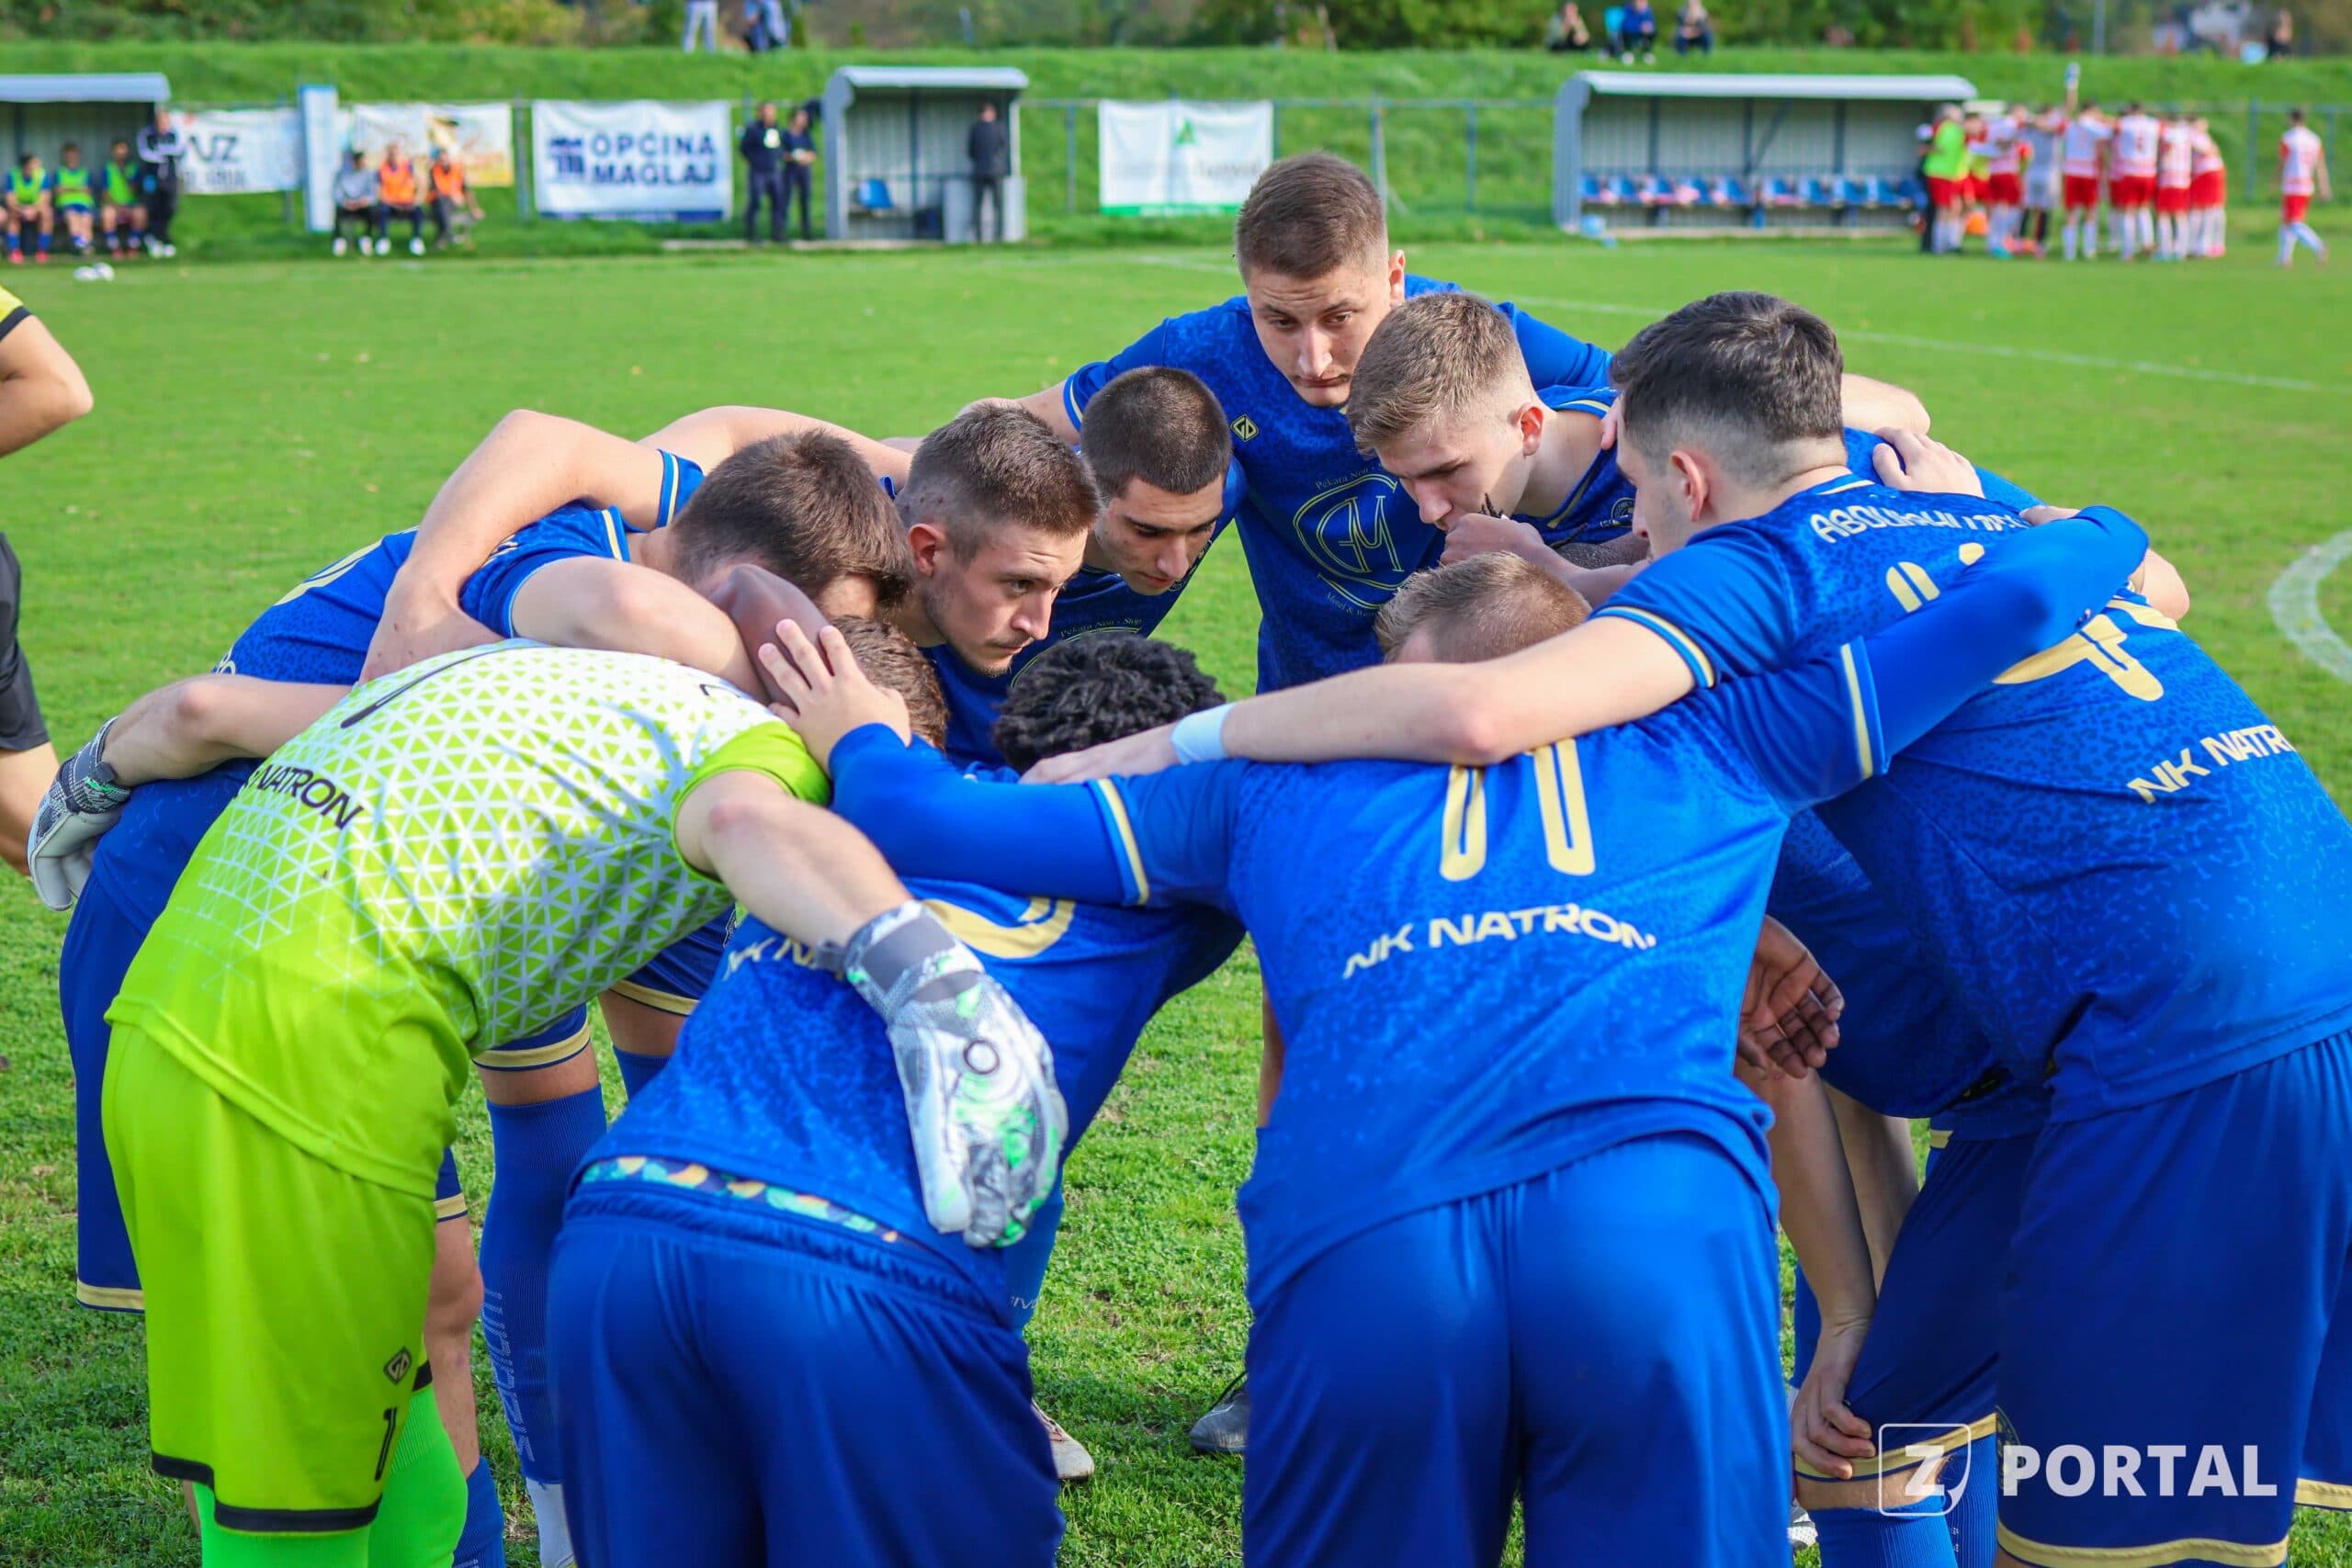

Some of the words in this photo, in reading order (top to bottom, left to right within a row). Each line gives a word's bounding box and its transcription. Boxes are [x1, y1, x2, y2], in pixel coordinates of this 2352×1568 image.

[594, 164, 717, 185] MAGLAJ
[257, 764, 364, 829] NATRON
[2126, 748, 2211, 805] NK
[2199, 724, 2297, 767] NATR
[1342, 923, 1415, 980] NK
[1428, 902, 1657, 951] NATRON
